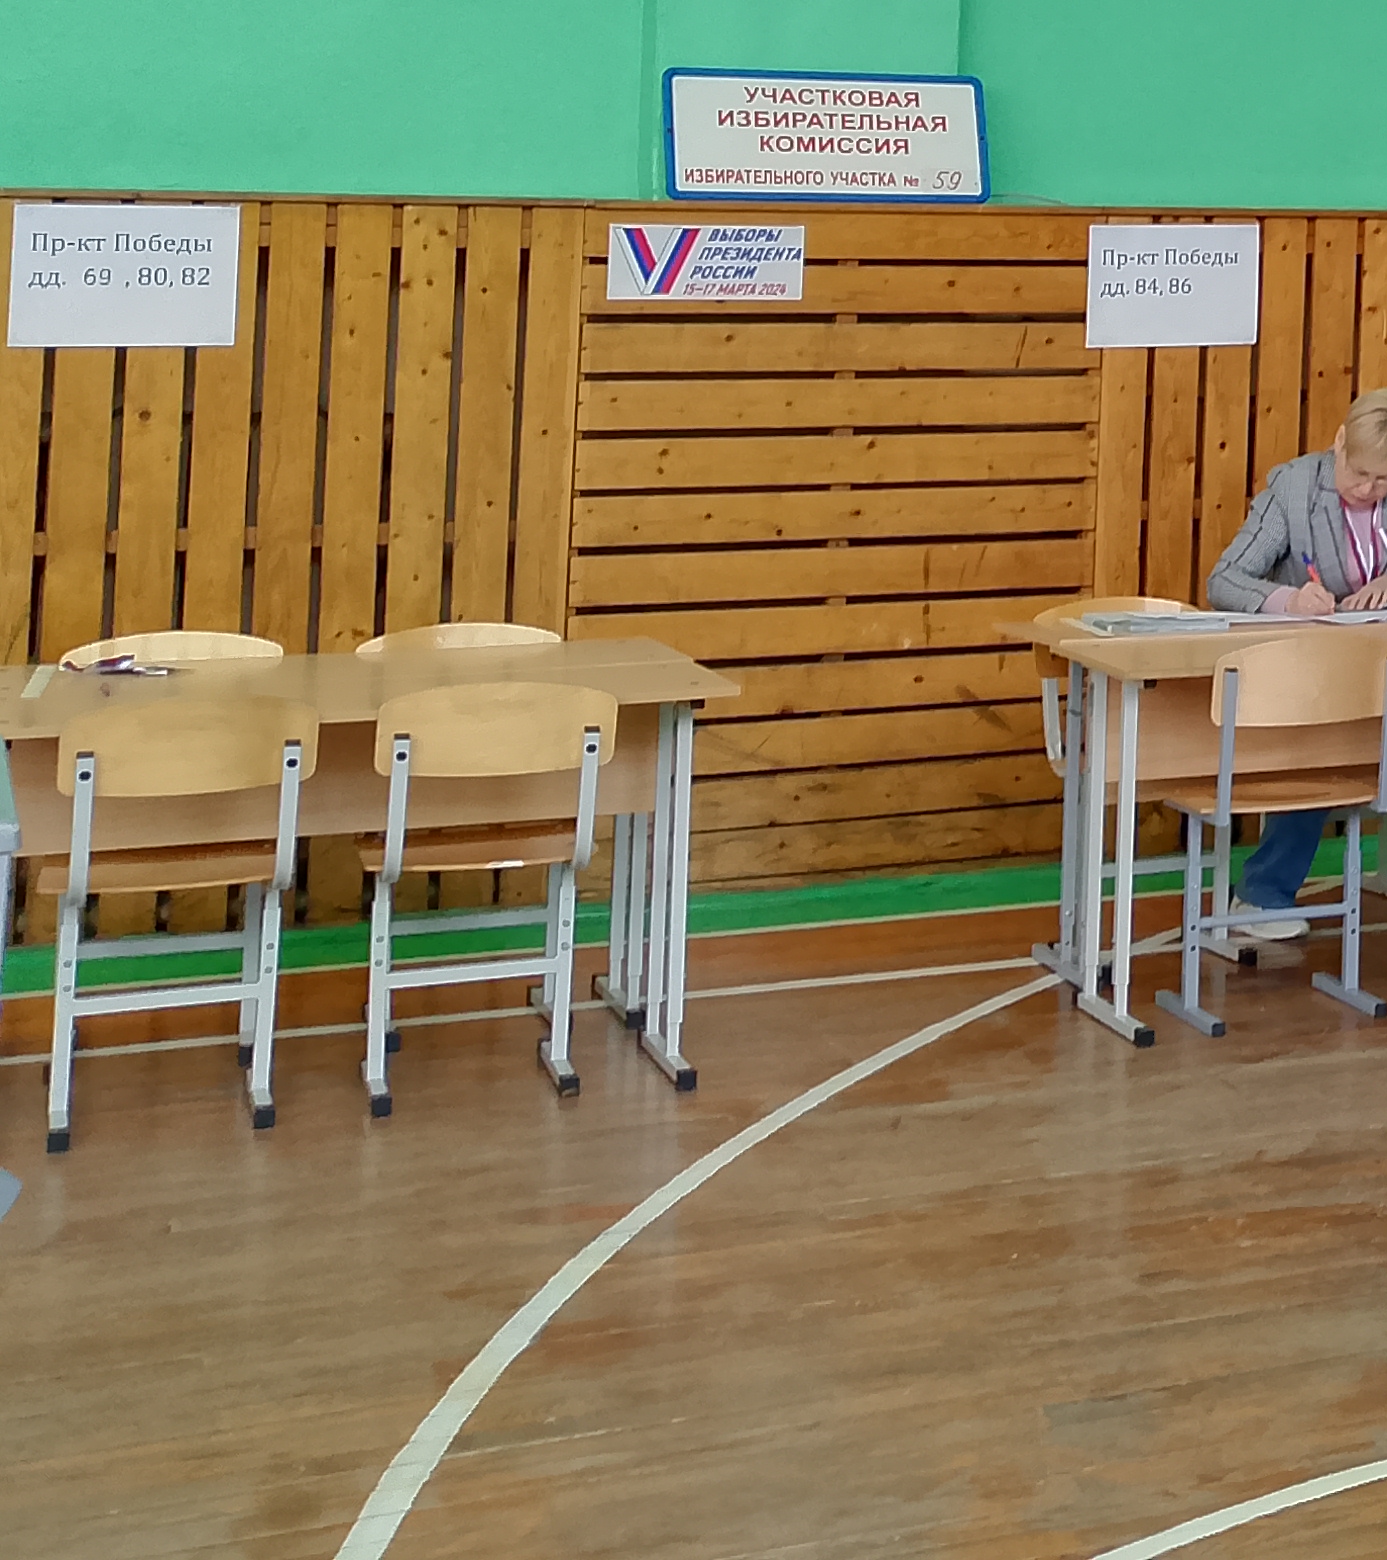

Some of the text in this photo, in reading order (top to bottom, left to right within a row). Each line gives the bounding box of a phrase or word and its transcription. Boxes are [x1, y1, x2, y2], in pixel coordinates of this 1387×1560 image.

[744, 86, 920, 108] УЧАСТКОВАЯ
[718, 110, 947, 132] ИЗБИРАТЕЛЬНАЯ
[759, 136, 910, 155] КОМИССИЯ
[684, 168, 824, 186] ИЗБИРАТЕЛЬНОГО
[831, 171, 897, 187] УЧАСТКА
[932, 171, 963, 190] 59
[31, 232, 212, 256] Пр-кт Победы
[707, 228, 782, 242] ВЫБОРЫ
[698, 247, 802, 262] ПРЕЗИДЕНТА
[1102, 248, 1239, 270] Пр-кт Победы
[28, 272, 66, 288] дд.
[84, 268, 111, 286] 69
[138, 268, 174, 288] 80,
[182, 268, 210, 286] 82
[690, 266, 758, 280] РОССИИ
[717, 284, 756, 296] МАРТА
[758, 283, 787, 296] 2024
[1100, 278, 1192, 298] дд. 84, 86
